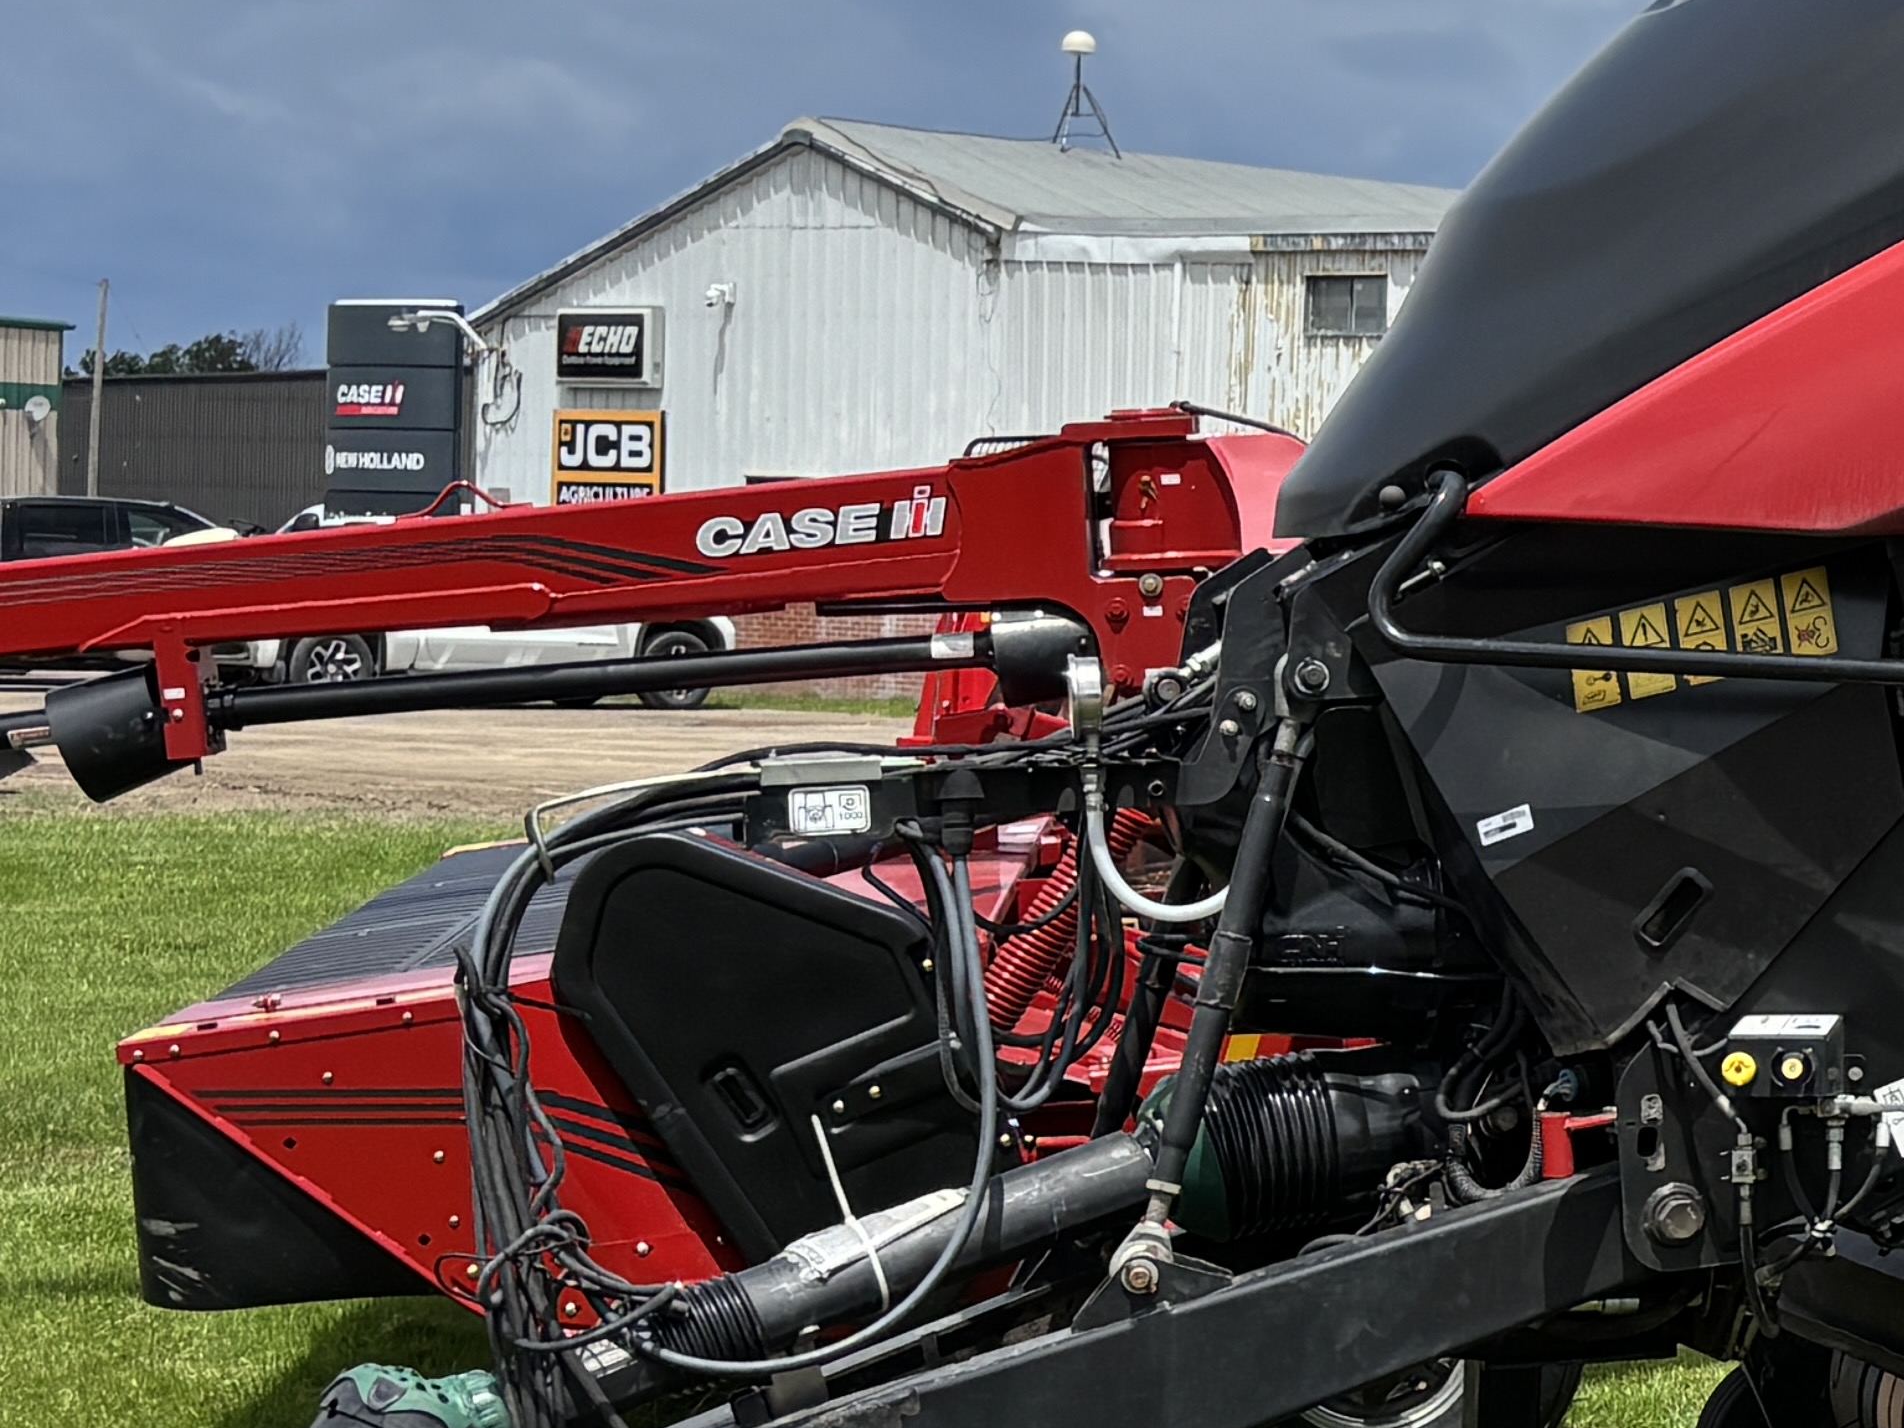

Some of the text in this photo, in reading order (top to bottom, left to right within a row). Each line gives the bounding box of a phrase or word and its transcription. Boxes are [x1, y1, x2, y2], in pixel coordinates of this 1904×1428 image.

[578, 325, 639, 353] ECHO
[337, 384, 383, 403] CASE
[560, 423, 652, 468] JCB
[358, 452, 425, 470] HOLLAND
[695, 502, 881, 558] CASE
